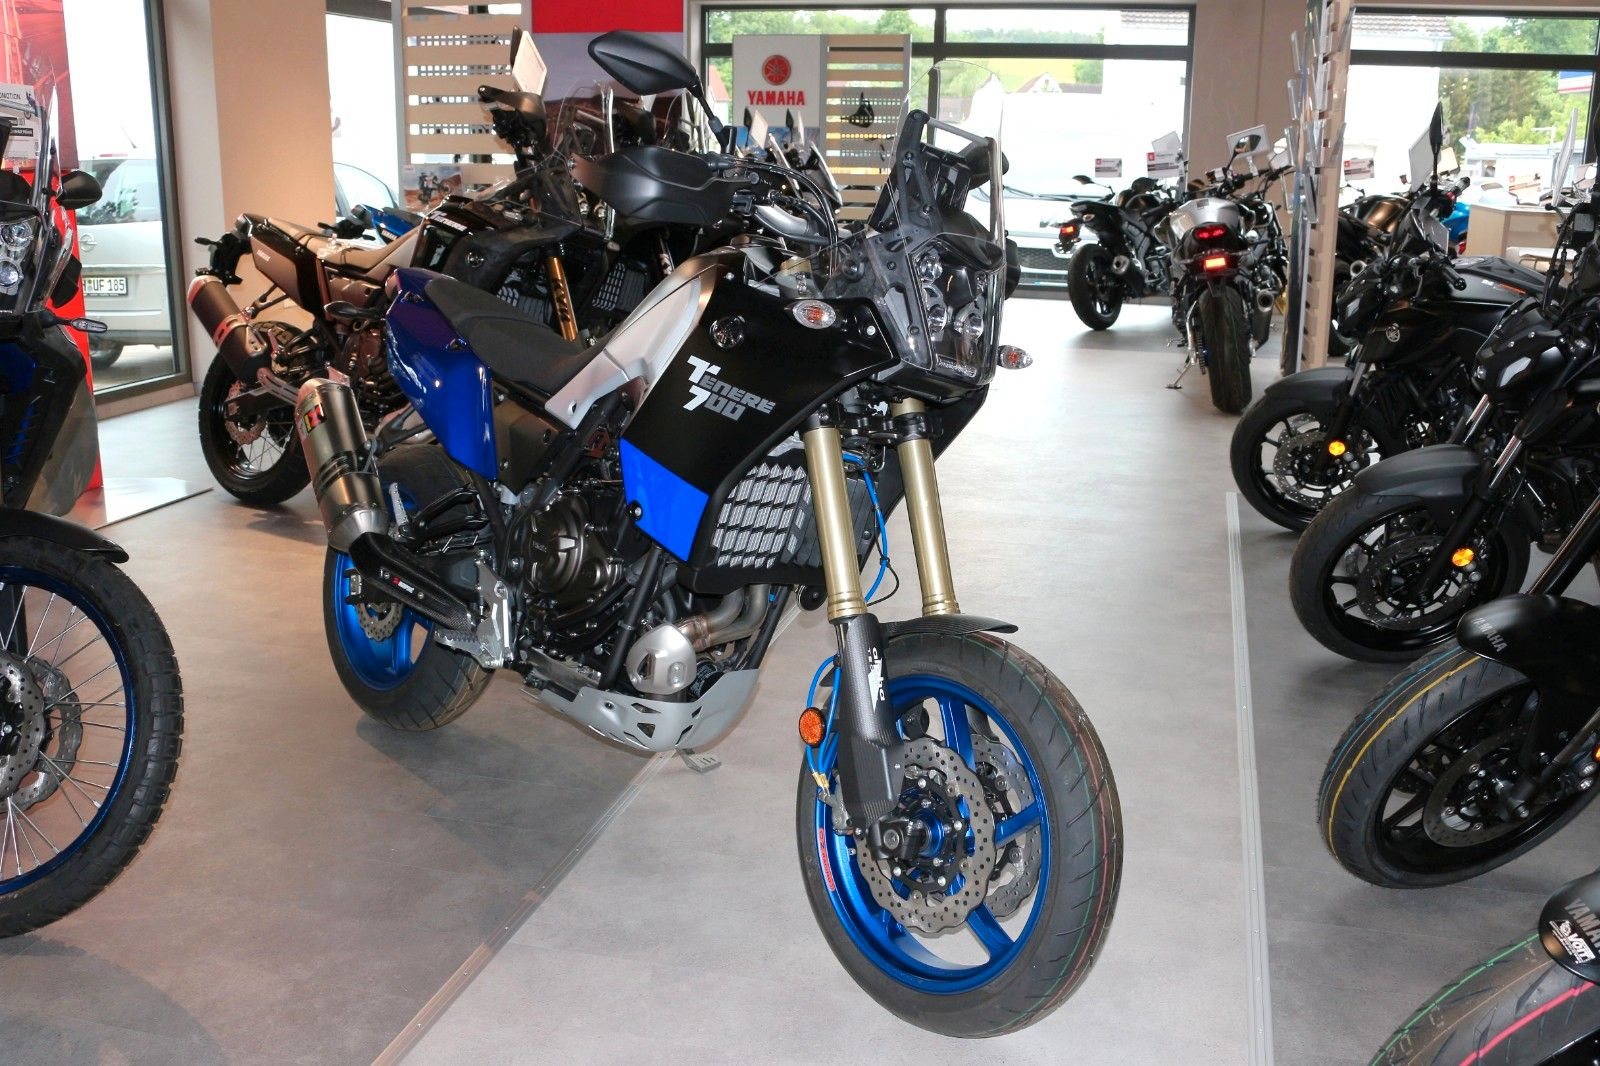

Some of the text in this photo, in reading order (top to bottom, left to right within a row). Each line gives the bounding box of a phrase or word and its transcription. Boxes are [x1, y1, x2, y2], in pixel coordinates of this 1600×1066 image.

[748, 90, 805, 106] YAMAHA
[93, 279, 105, 291] UF
[107, 279, 125, 291] 185
[683, 385, 746, 421] 700
